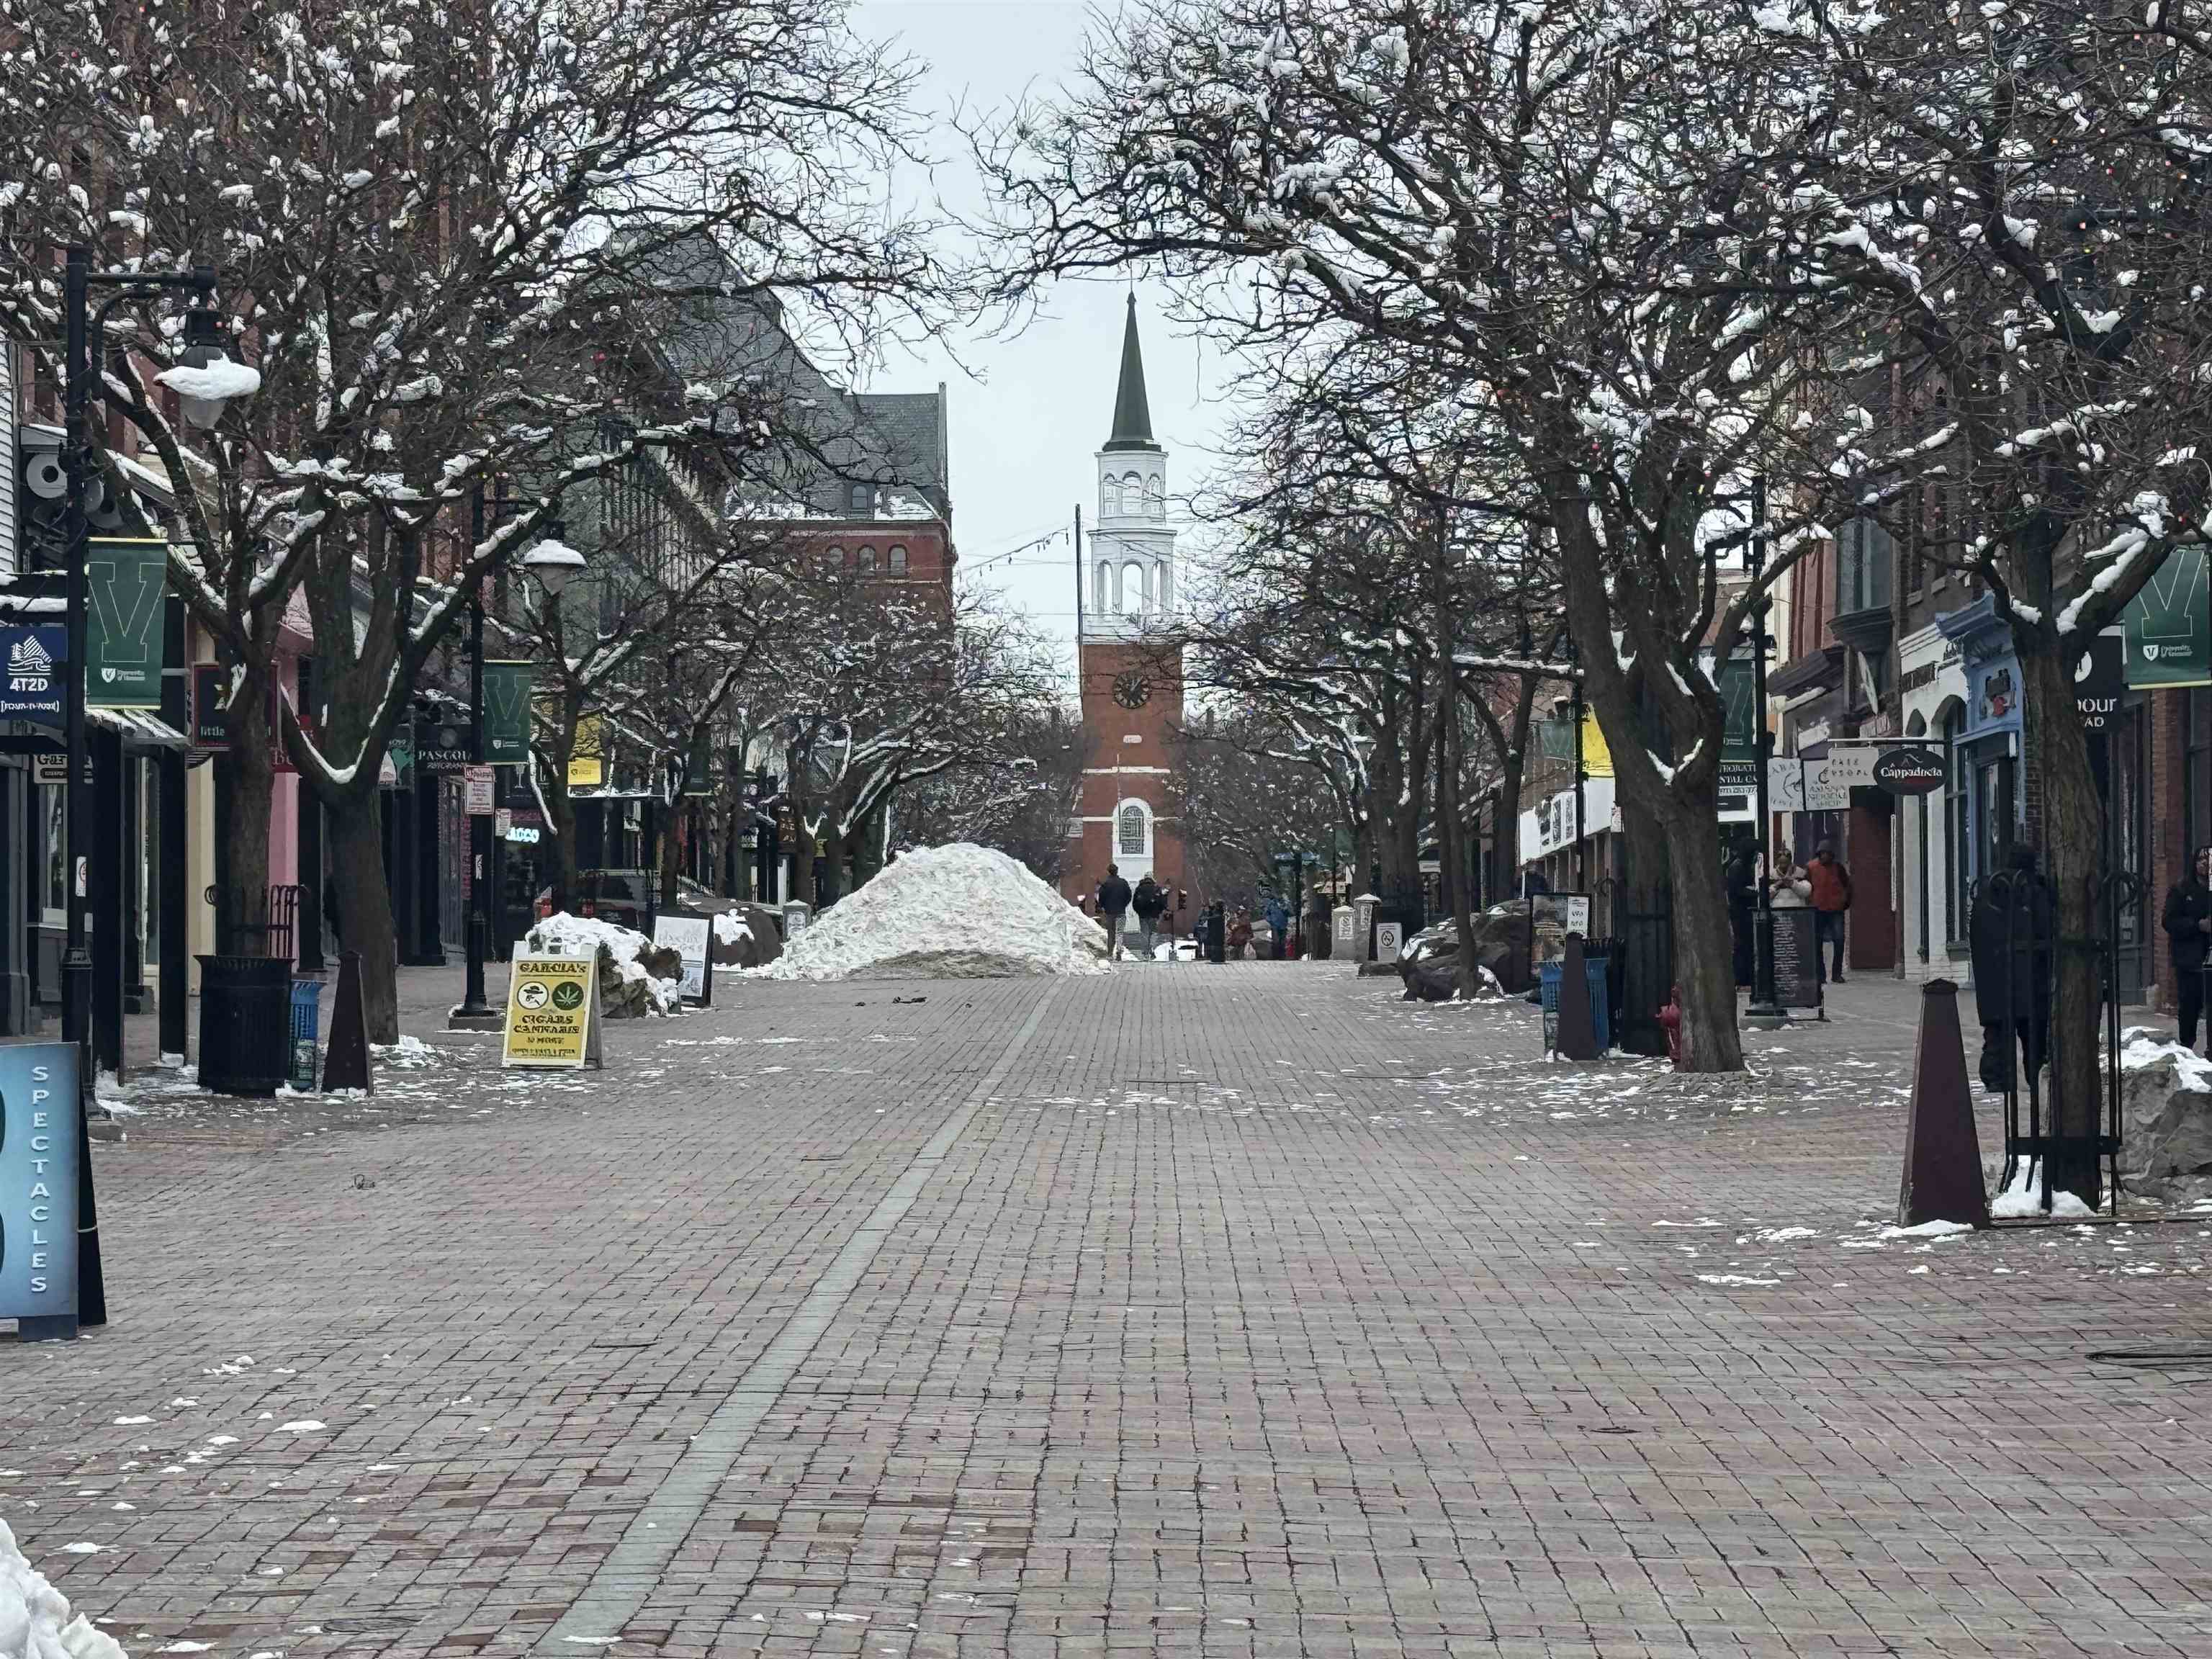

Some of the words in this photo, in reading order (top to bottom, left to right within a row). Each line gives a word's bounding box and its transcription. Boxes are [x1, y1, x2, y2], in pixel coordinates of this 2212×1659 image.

[9, 678, 48, 691] 4T2D
[1881, 765, 1943, 778] Cappadocia
[522, 1015, 574, 1024] CIGARS
[513, 1025, 580, 1033] CANNABIS
[30, 1066, 51, 1293] SPECTACLES
